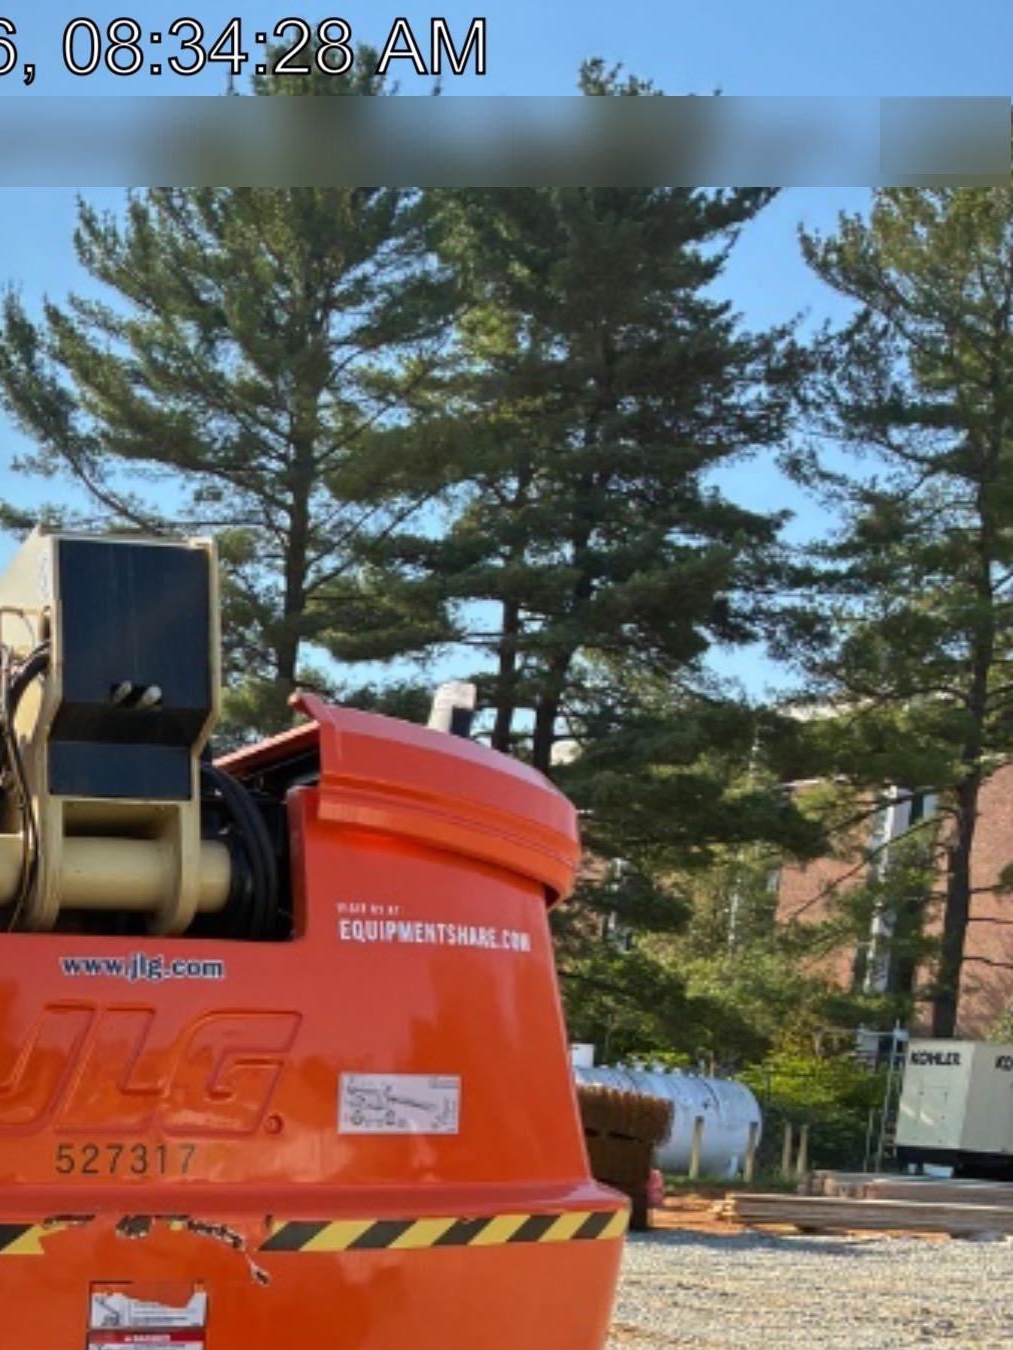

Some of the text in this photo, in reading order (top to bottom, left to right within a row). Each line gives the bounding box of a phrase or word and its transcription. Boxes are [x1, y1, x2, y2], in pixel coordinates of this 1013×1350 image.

[338, 919, 533, 952] EQUIPMENTSHARE.COM
[61, 953, 225, 982] www.jlg.com
[910, 1052, 961, 1066] KOHLER
[55, 1143, 196, 1175] 527317
